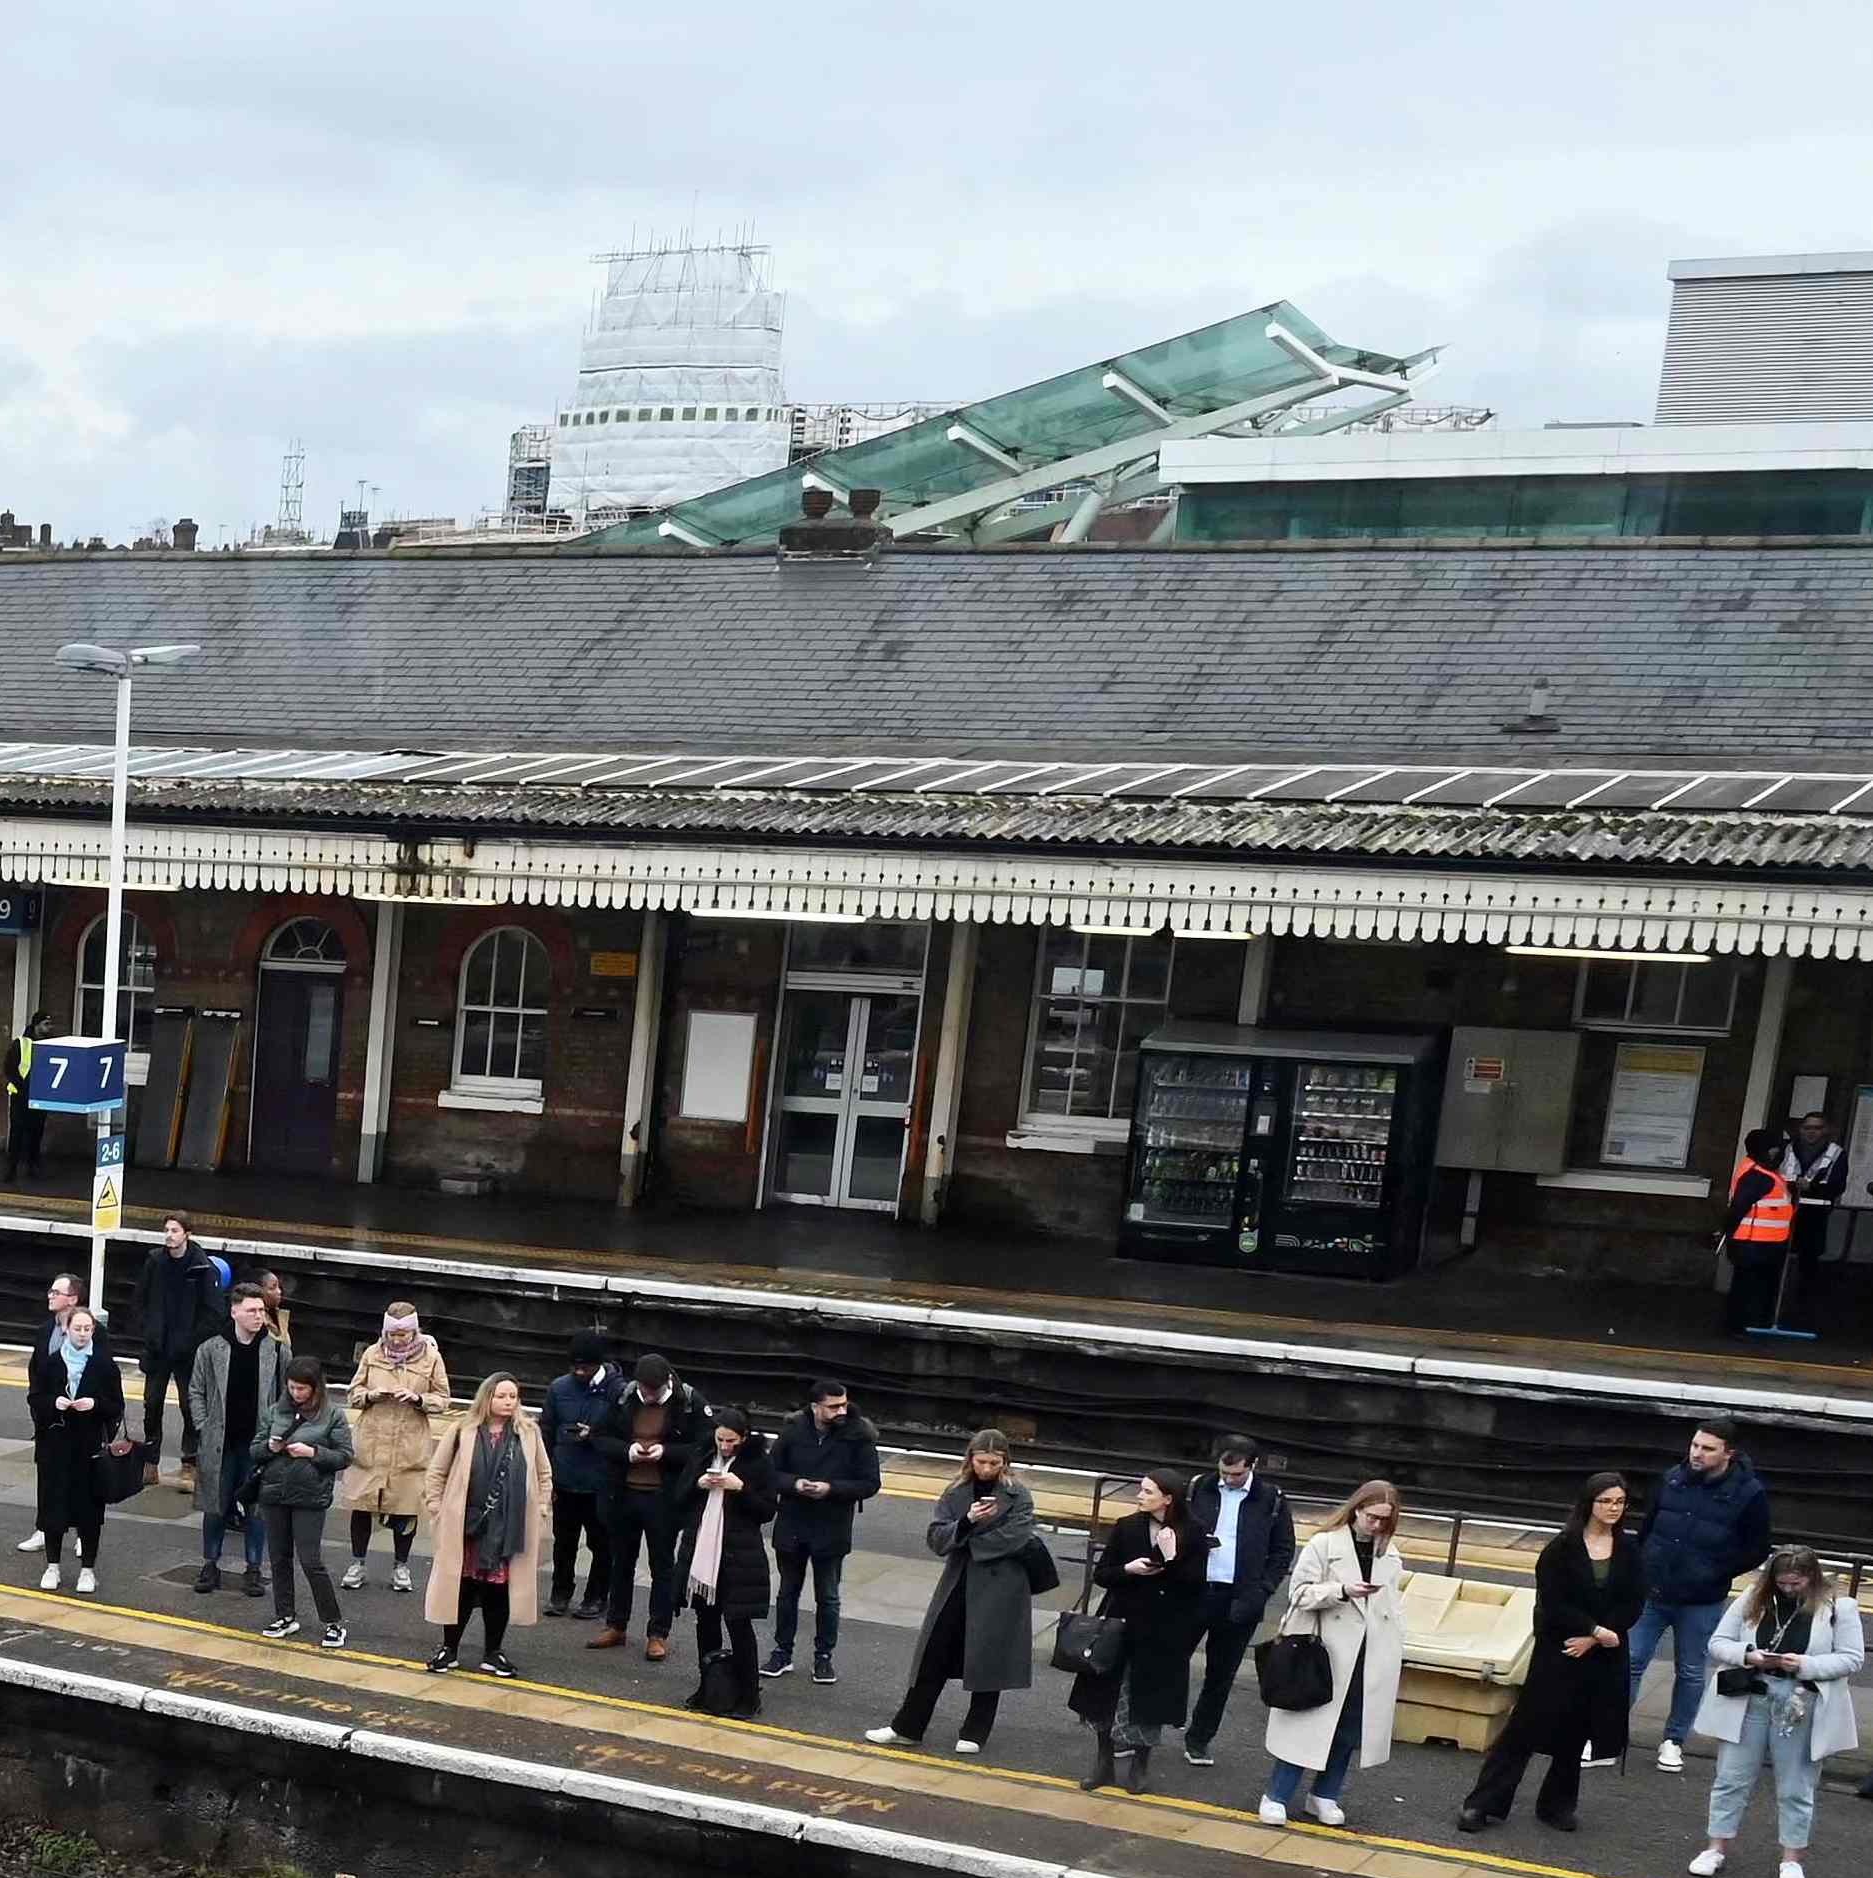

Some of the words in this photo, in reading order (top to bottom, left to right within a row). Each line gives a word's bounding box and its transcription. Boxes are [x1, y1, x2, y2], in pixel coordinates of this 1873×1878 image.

[49, 1057, 69, 1089] 7
[99, 1056, 113, 1089] 7
[101, 1141, 120, 1162] 2-6
